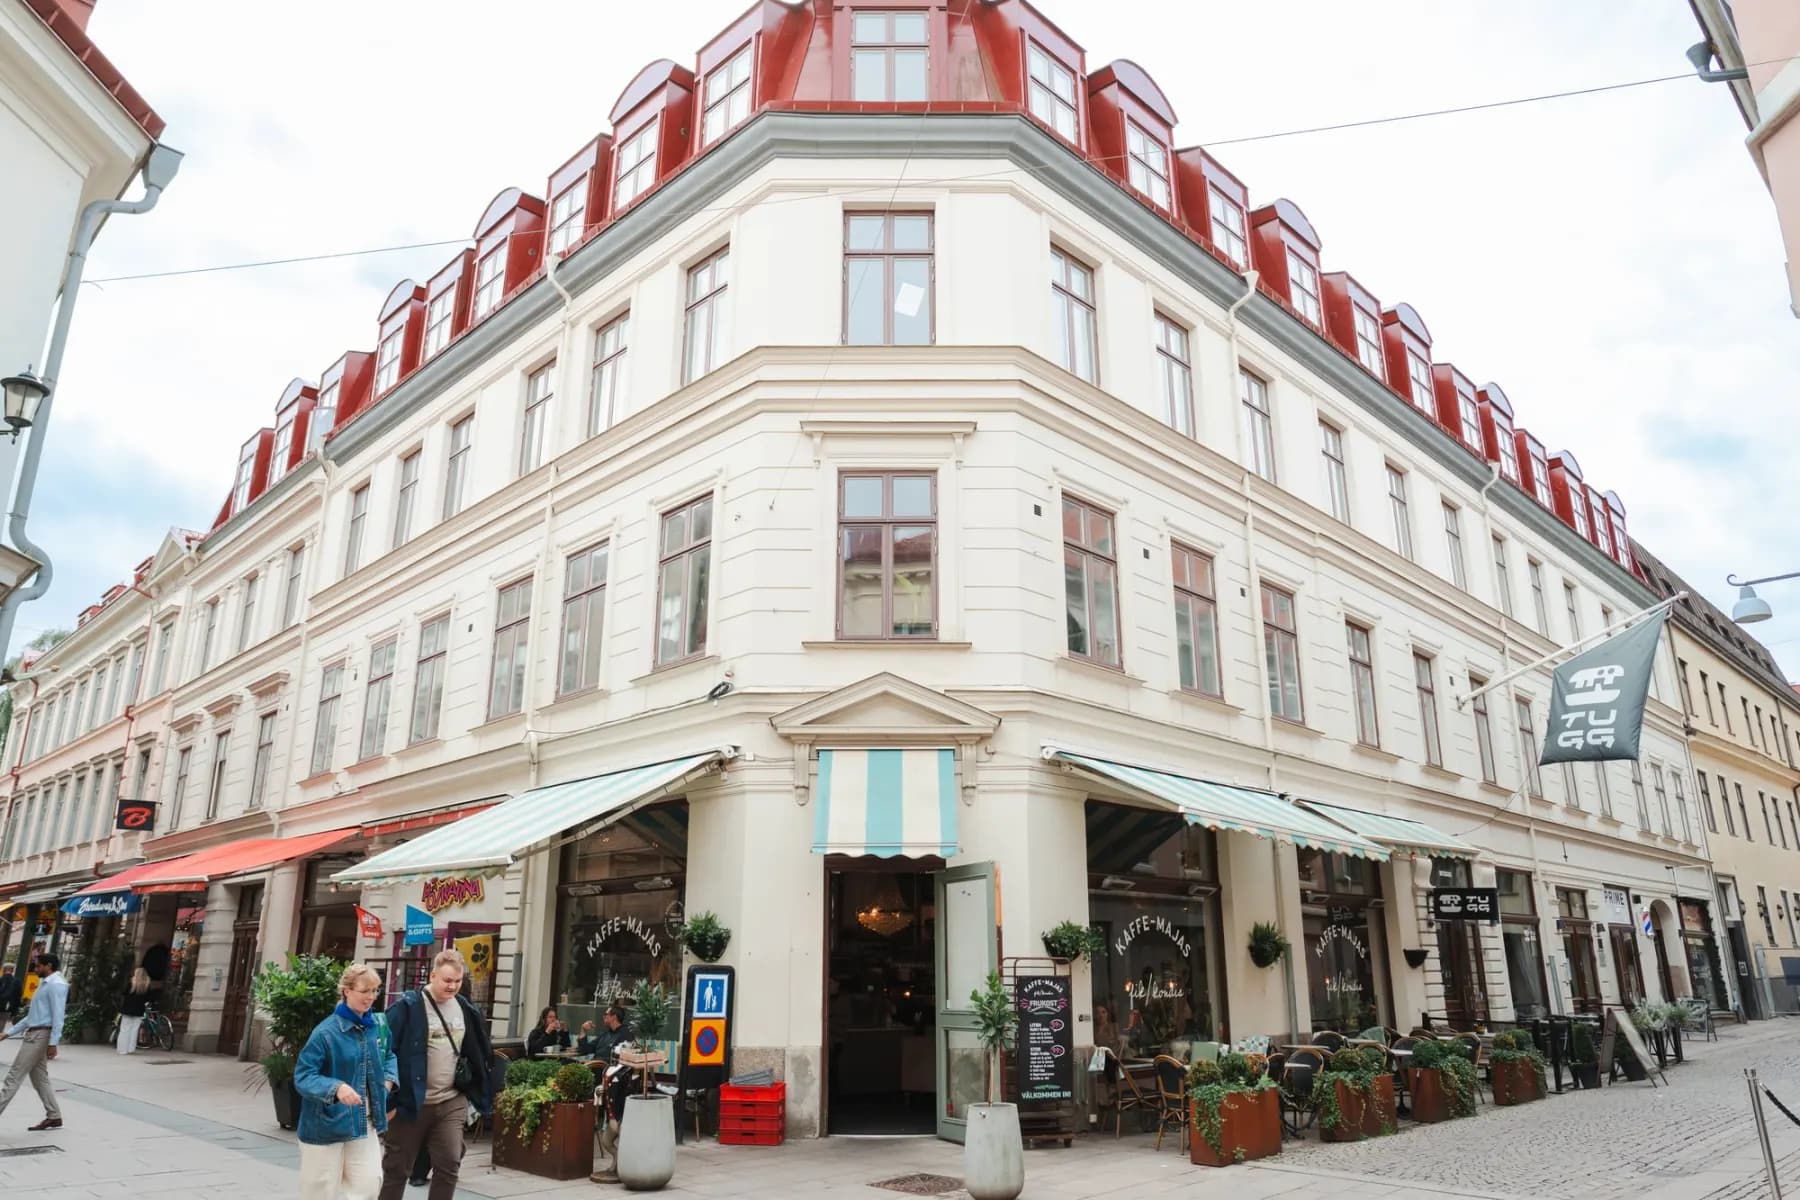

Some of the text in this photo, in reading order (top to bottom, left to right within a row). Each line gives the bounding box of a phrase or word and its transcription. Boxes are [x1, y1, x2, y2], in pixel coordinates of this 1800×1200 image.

[1603, 890, 1625, 906] PRIME
[586, 916, 661, 958] KAFFE-MAJAS
[1115, 915, 1192, 957] KAFFE-MAJAS
[1315, 924, 1366, 959] KAFFE-MAJAS
[1024, 979, 1064, 993] KAFFE-MAJAS
[1129, 972, 1185, 1010] fik/kondis
[1029, 1000, 1058, 1008] FRUKOST
[1021, 1091, 1061, 1099] VÄLKOMMEN
